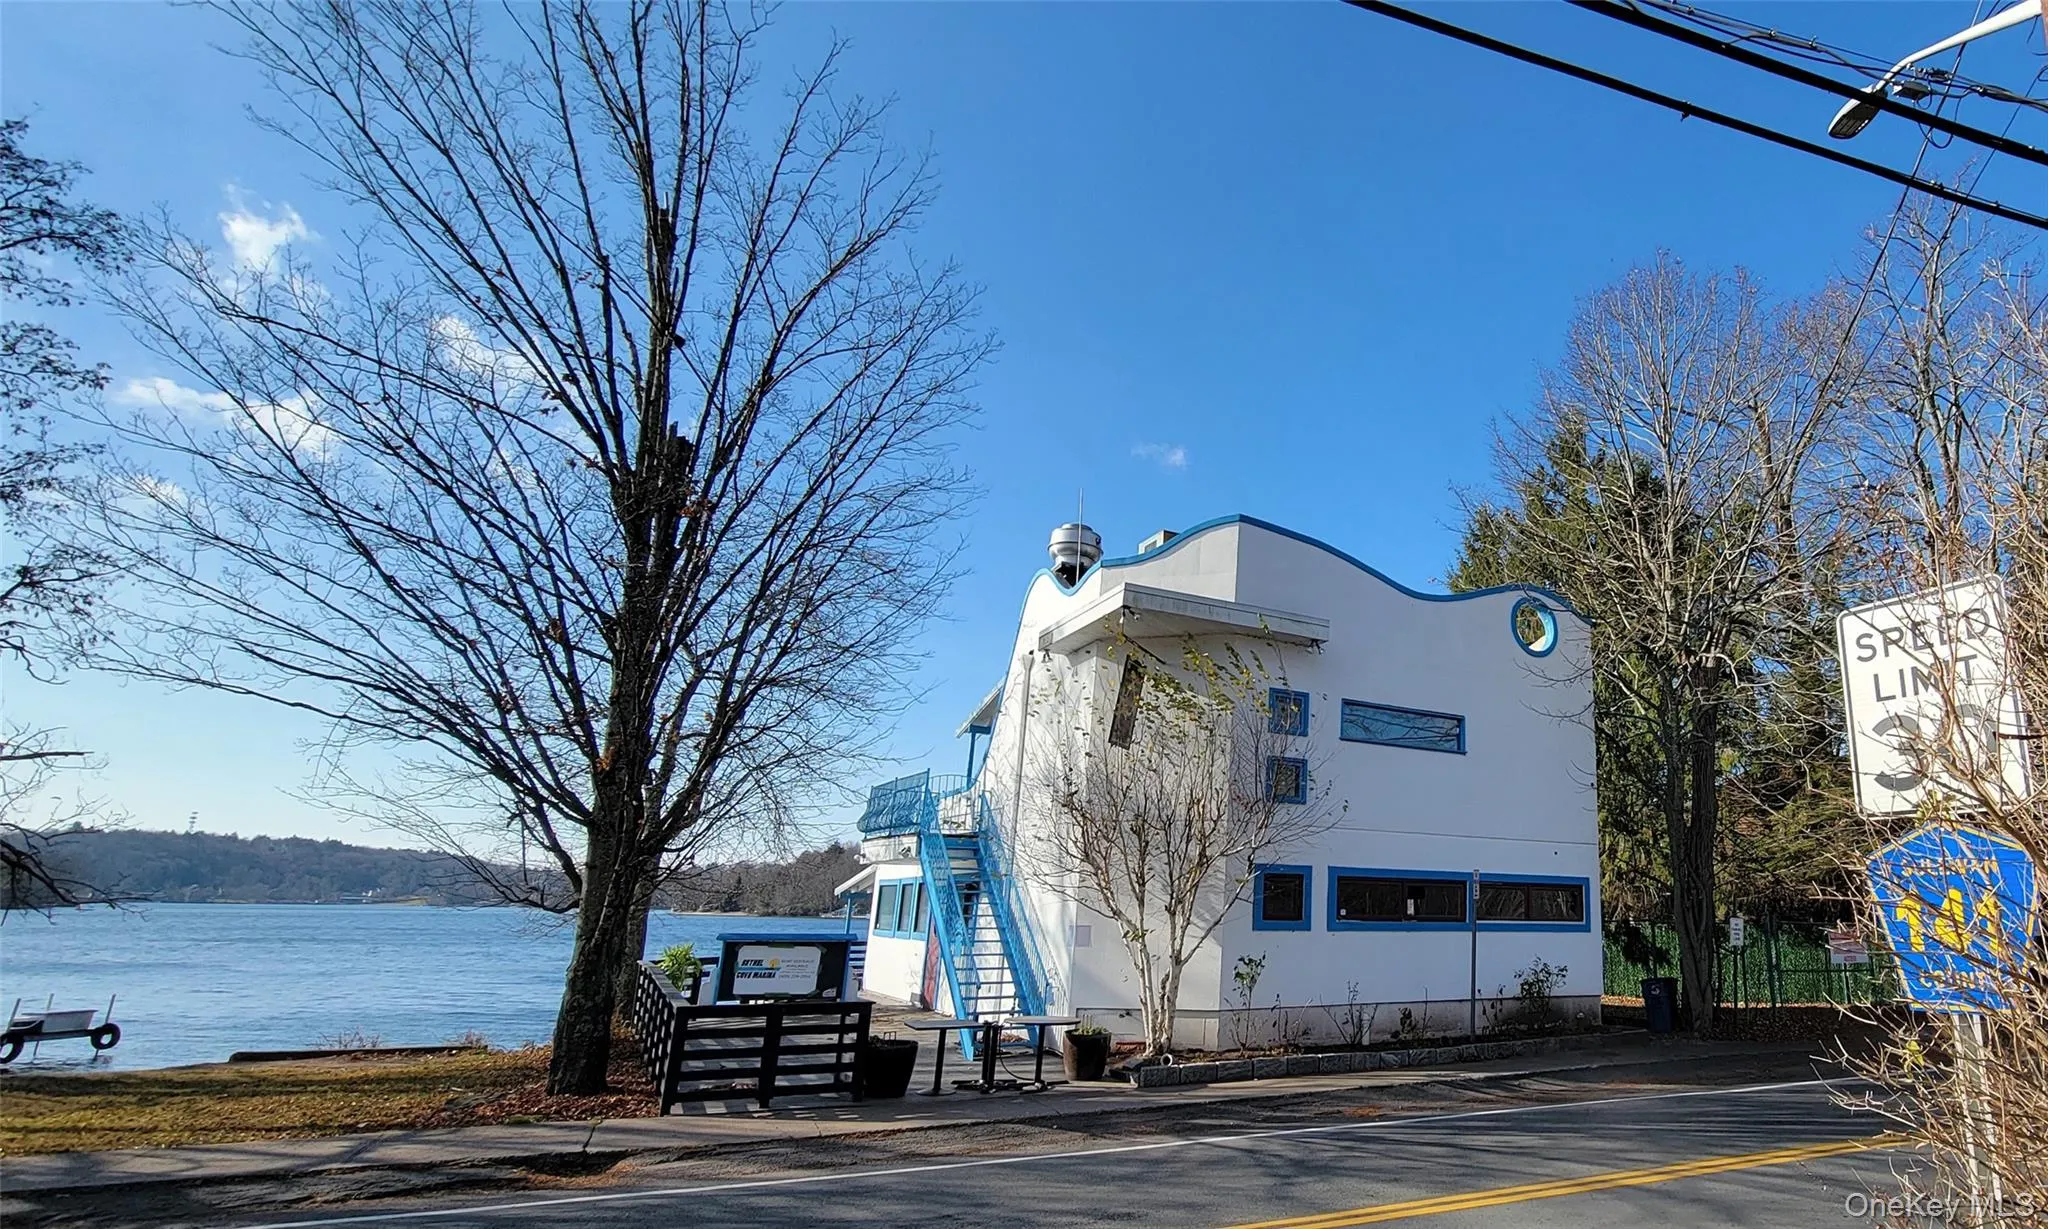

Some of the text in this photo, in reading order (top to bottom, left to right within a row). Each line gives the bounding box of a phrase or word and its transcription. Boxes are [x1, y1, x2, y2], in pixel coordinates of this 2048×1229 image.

[1856, 608, 1991, 662] SPEED
[1873, 653, 1978, 702] LIMIT
[736, 971, 752, 979] COVE
[752, 971, 776, 979] MARINA
